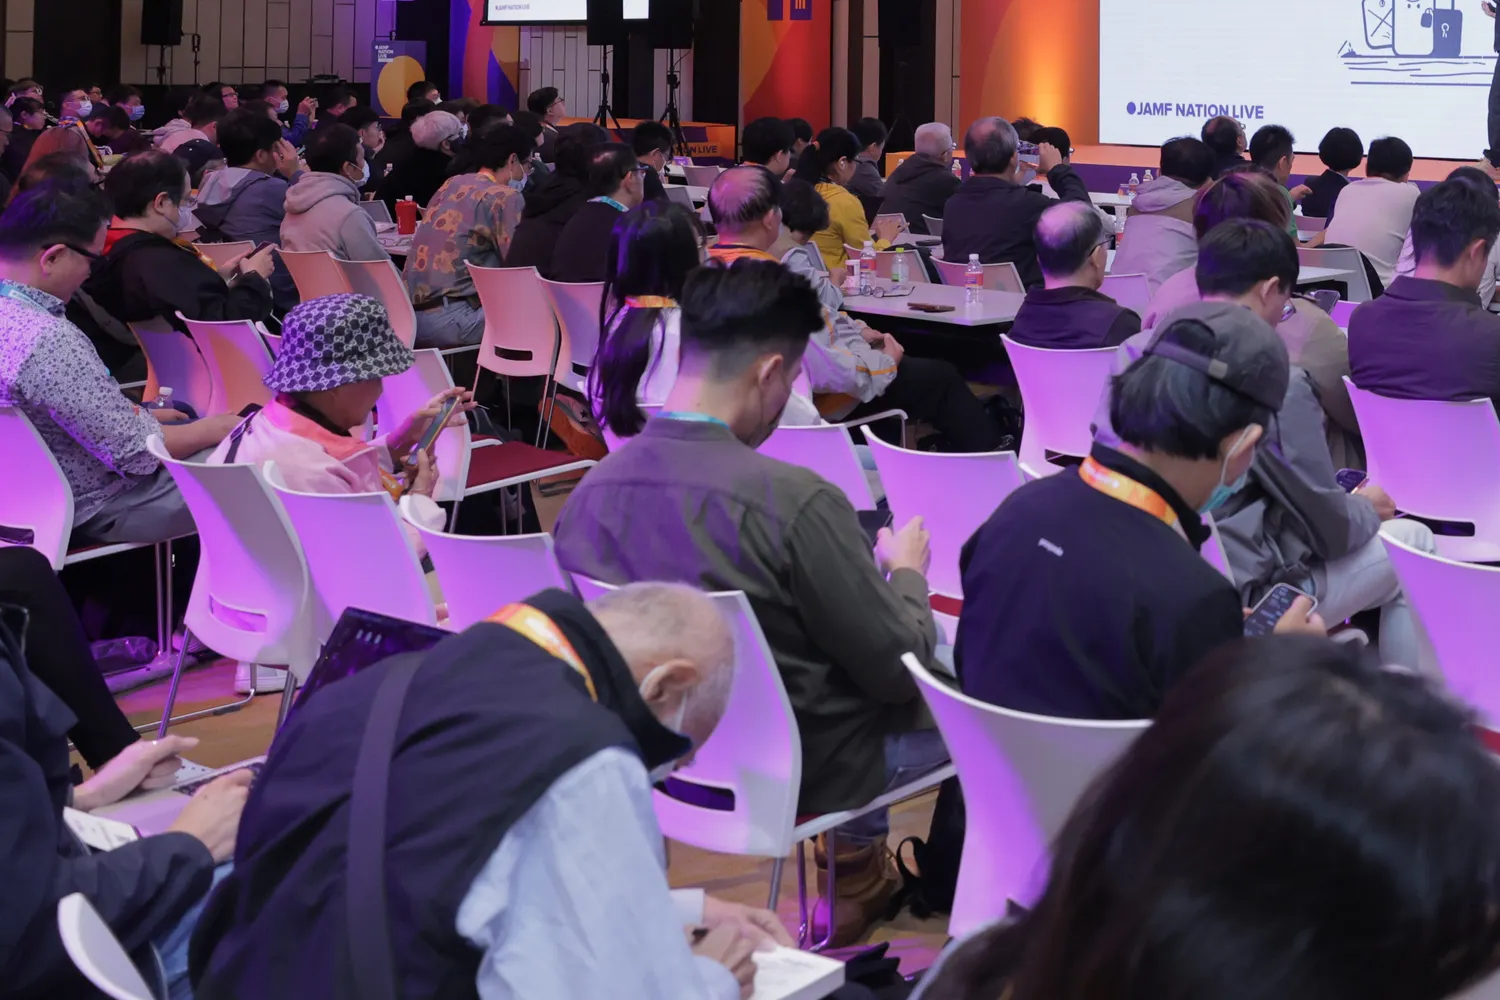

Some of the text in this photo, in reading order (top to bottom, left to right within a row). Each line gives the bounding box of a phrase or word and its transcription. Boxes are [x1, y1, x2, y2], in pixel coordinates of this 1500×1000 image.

[1136, 101, 1264, 119] JAMF NATION LIVE
